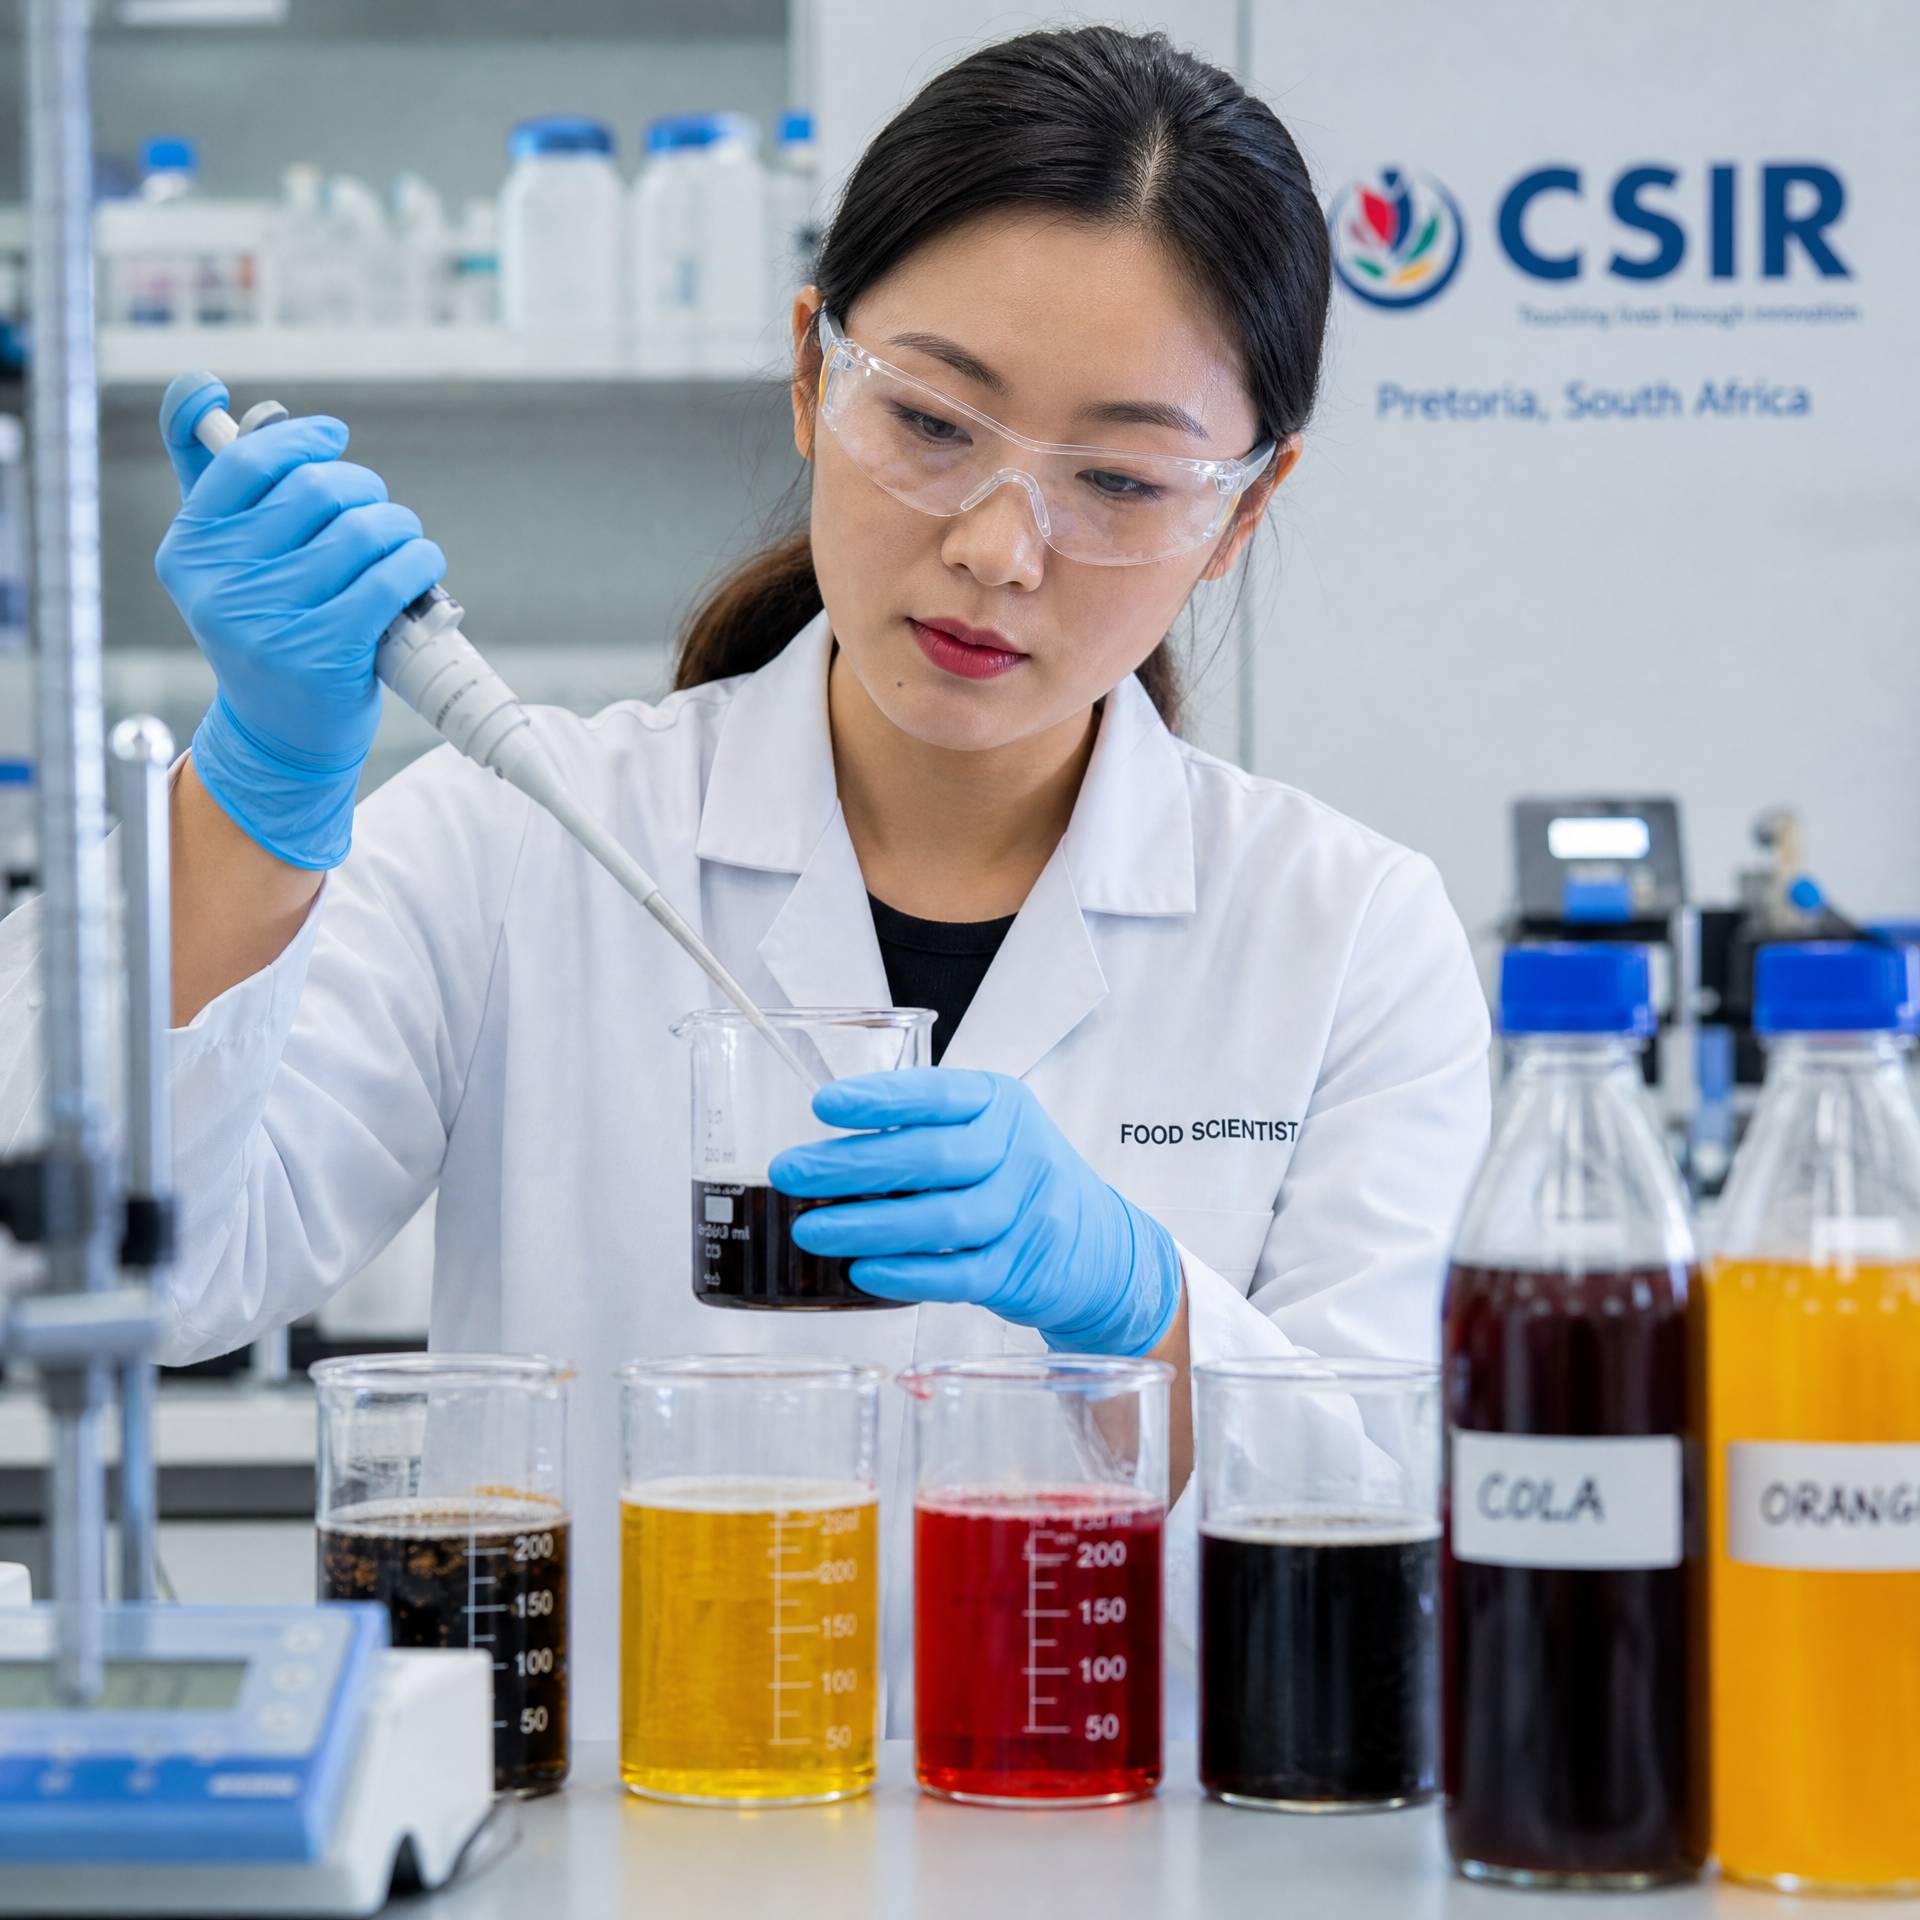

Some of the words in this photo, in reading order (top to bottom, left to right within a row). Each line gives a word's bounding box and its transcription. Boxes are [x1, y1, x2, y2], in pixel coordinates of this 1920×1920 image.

[1497, 162, 1854, 282] CSIR
[1377, 382, 1550, 424] Pretoria,
[1563, 382, 1684, 419] South
[1694, 380, 1812, 418] Africa
[1121, 1123, 1184, 1145] FOOD
[1191, 1118, 1299, 1142] SCIENTIST
[1477, 1471, 1605, 1525] COLA
[1760, 1480, 1920, 1527] ORANG
[514, 1532, 554, 1562] 200
[1077, 1540, 1128, 1569] 200
[515, 1589, 554, 1619] 150
[1078, 1596, 1127, 1625] 150
[821, 1612, 857, 1640] 150
[514, 1647, 553, 1677] 100
[1078, 1654, 1127, 1683] 100
[821, 1668, 857, 1696] 100
[520, 1705, 549, 1735] 50
[1084, 1713, 1120, 1741] 50
[825, 1723, 853, 1751] 50
